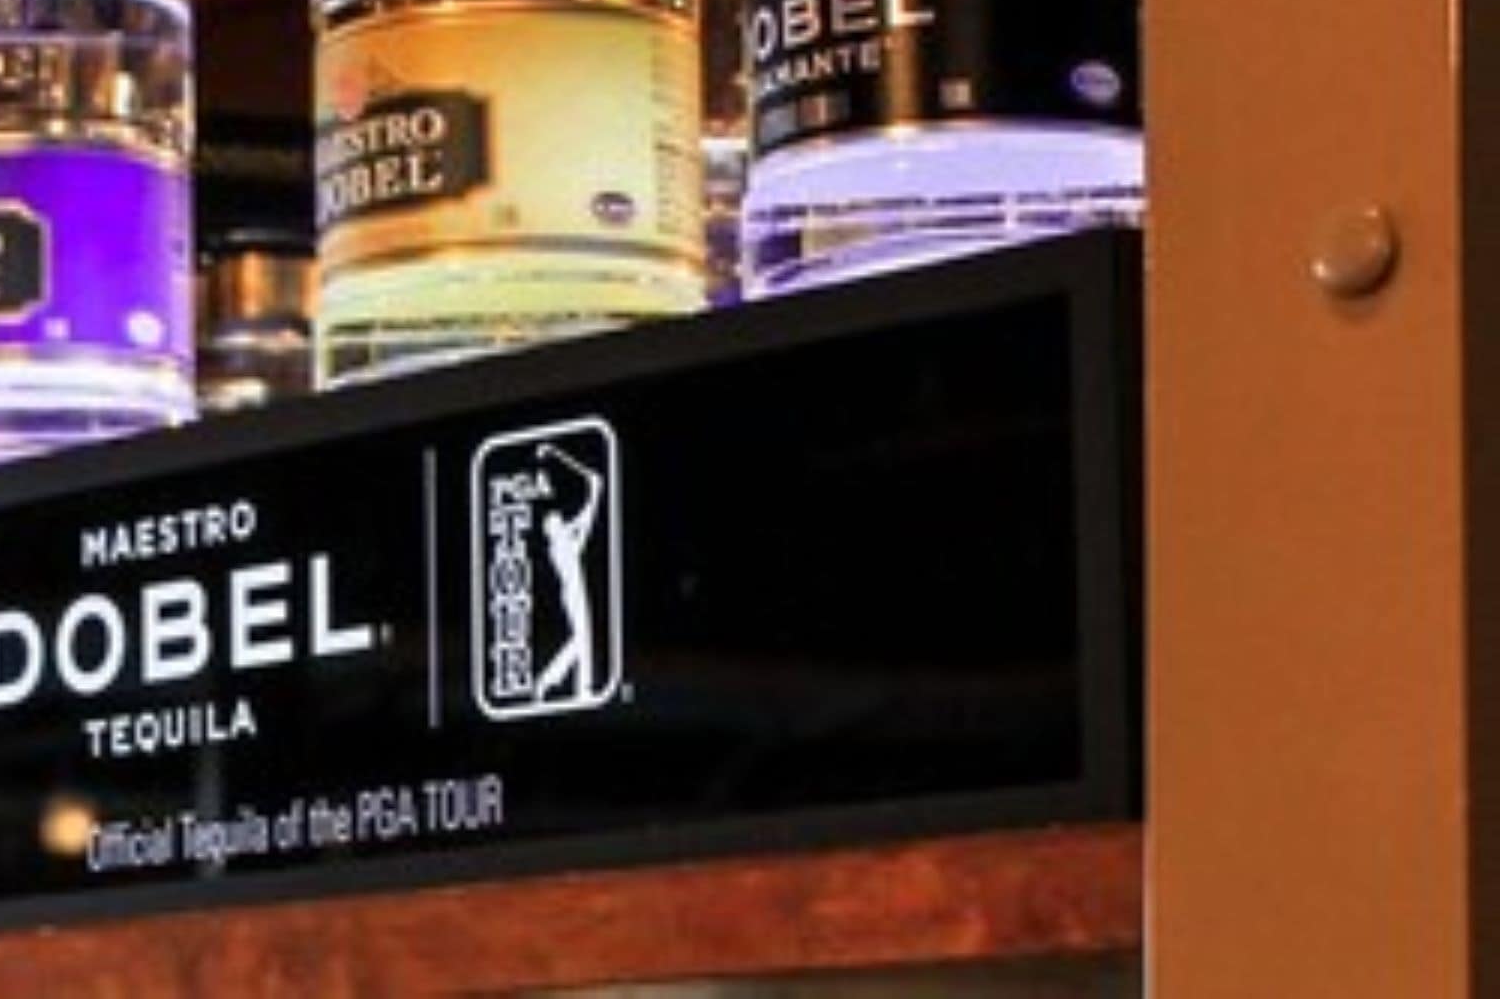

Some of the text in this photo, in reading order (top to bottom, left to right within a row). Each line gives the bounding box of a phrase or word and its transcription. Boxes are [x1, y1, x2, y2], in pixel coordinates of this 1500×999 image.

[488, 471, 553, 504] PGA
[79, 498, 258, 567] MAESTRO
[488, 502, 534, 697] TOUR
[83, 698, 259, 758] TEQUILA
[86, 773, 502, 874] Official Tequila of the PGA TOUR
